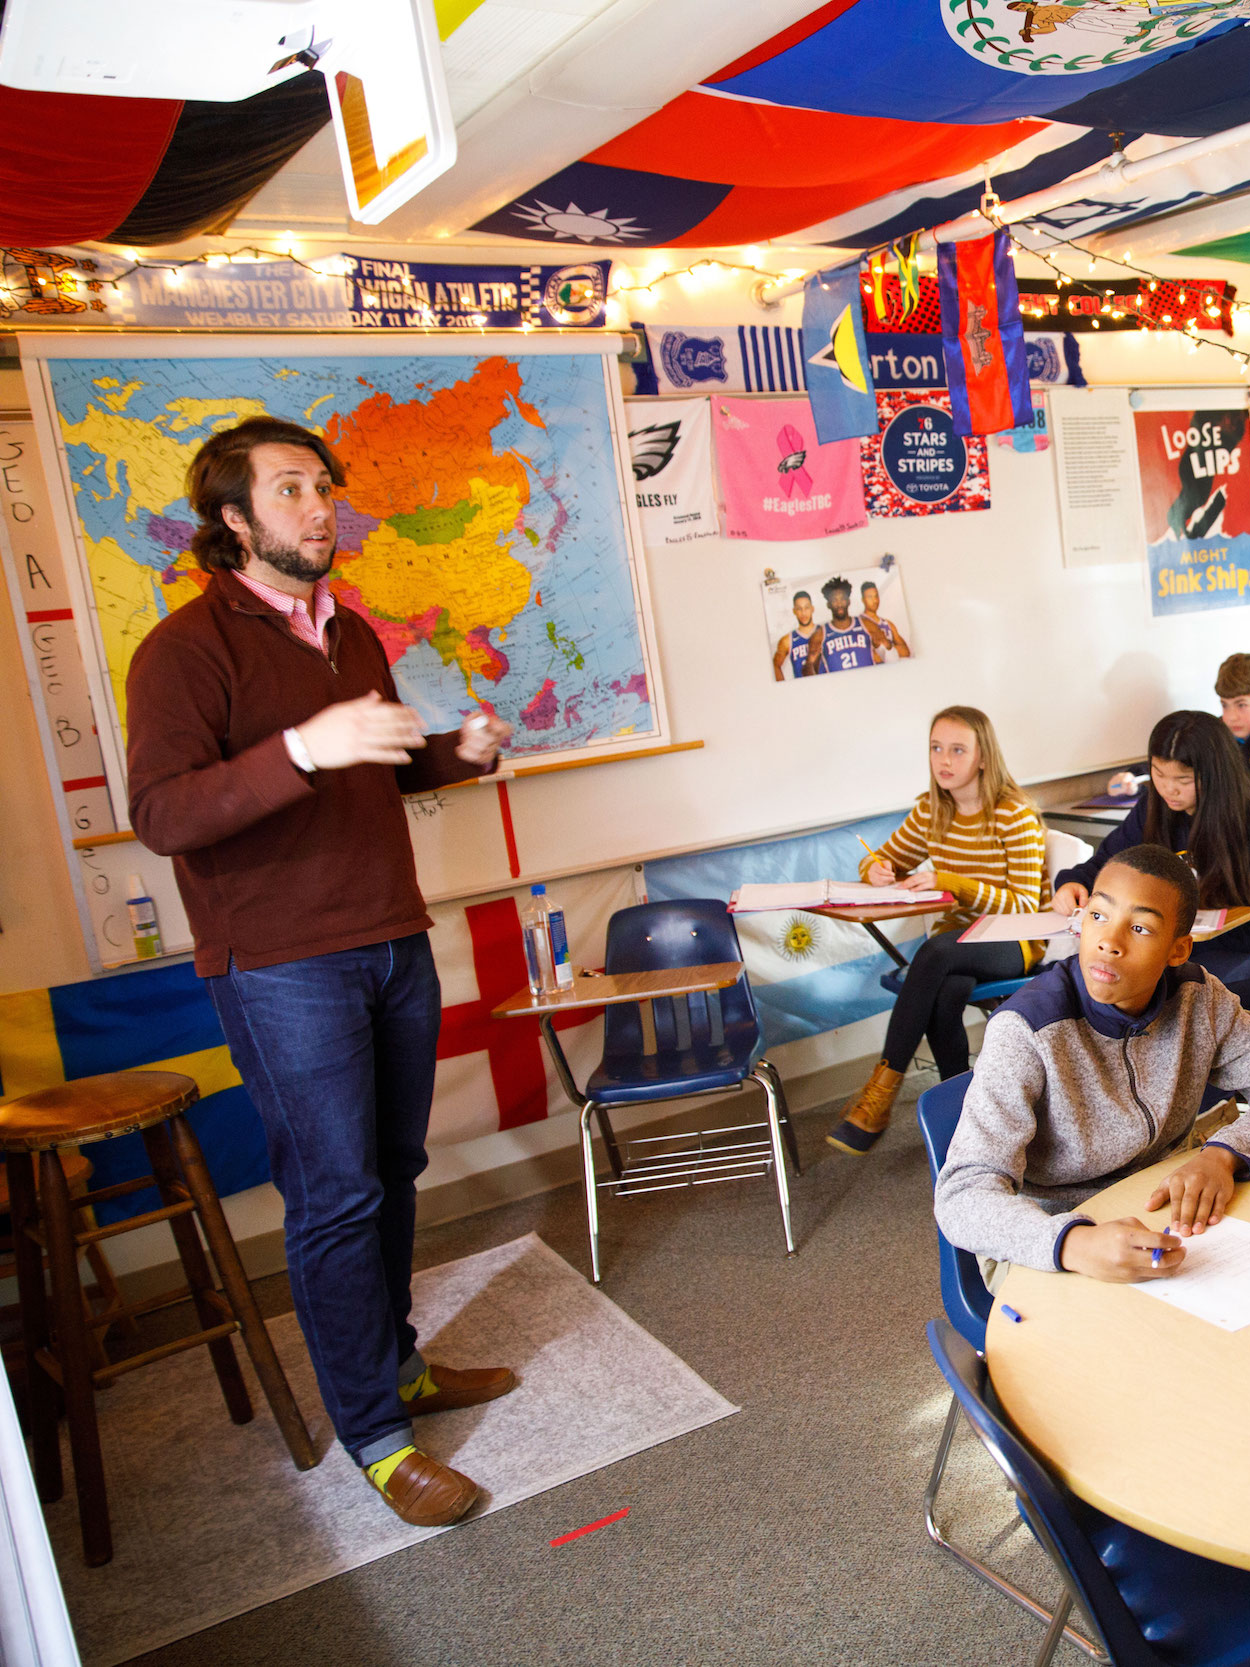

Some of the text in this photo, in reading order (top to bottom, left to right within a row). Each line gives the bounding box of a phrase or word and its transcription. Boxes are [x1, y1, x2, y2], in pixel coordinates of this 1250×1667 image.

[360, 259, 415, 280] FINAL
[356, 278, 430, 312] WIGAN
[435, 282, 518, 314] ATHLETIC
[184, 311, 285, 326] WEMBLEY
[285, 311, 382, 327] SATURDAY
[869, 348, 939, 380] rton
[903, 432, 947, 446] STARS
[1161, 422, 1222, 460] LOOSE
[916, 447, 936, 457] AND
[898, 458, 954, 472] STRIPES
[1189, 447, 1242, 479] LIPS
[919, 483, 949, 491] TOYOTA
[635, 493, 678, 508] GLES FLY
[763, 493, 831, 516] #EaglesTBC
[386, 548, 468, 569] CHINA
[1180, 547, 1229, 565] MIGHT
[1158, 566, 1204, 597] Sink
[826, 634, 867, 656] PHILA
[840, 651, 858, 669] 21
